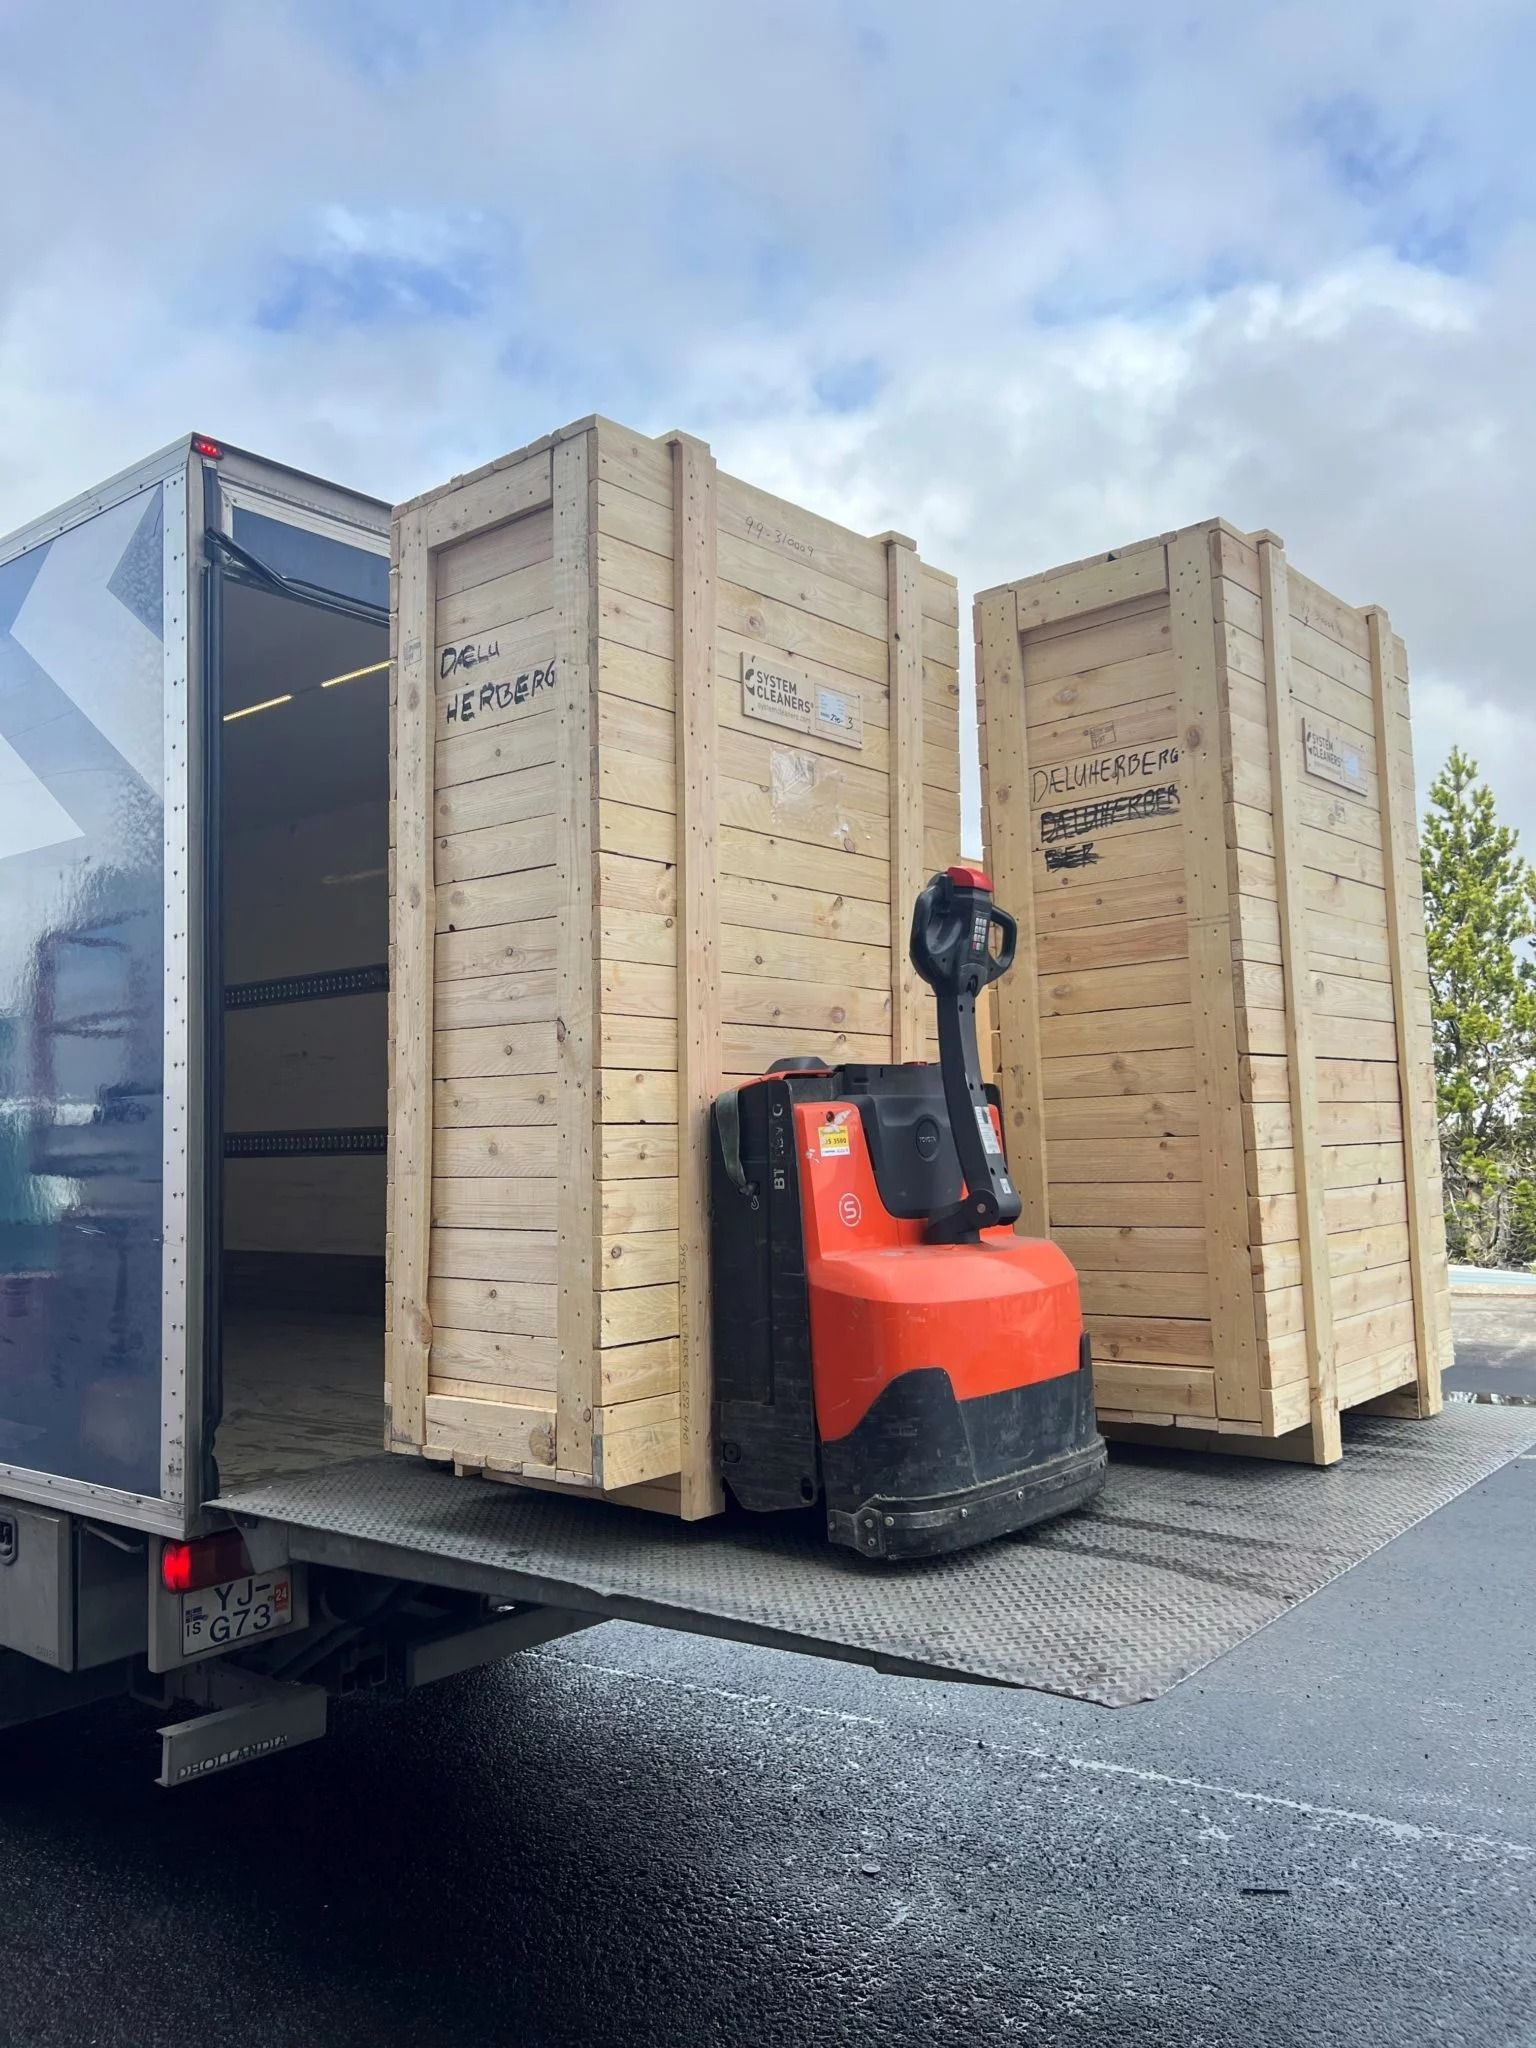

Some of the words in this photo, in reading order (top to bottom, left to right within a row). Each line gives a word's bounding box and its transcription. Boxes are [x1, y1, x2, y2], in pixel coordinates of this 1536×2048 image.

[446, 658, 557, 724] HERBERG
[756, 670, 797, 696] SYSTEM
[1311, 733, 1334, 752] SYSTEM
[185, 1622, 202, 1637] IS
[209, 1604, 271, 1642] G73
[177, 1735, 288, 1780] DHOLLANDIA
